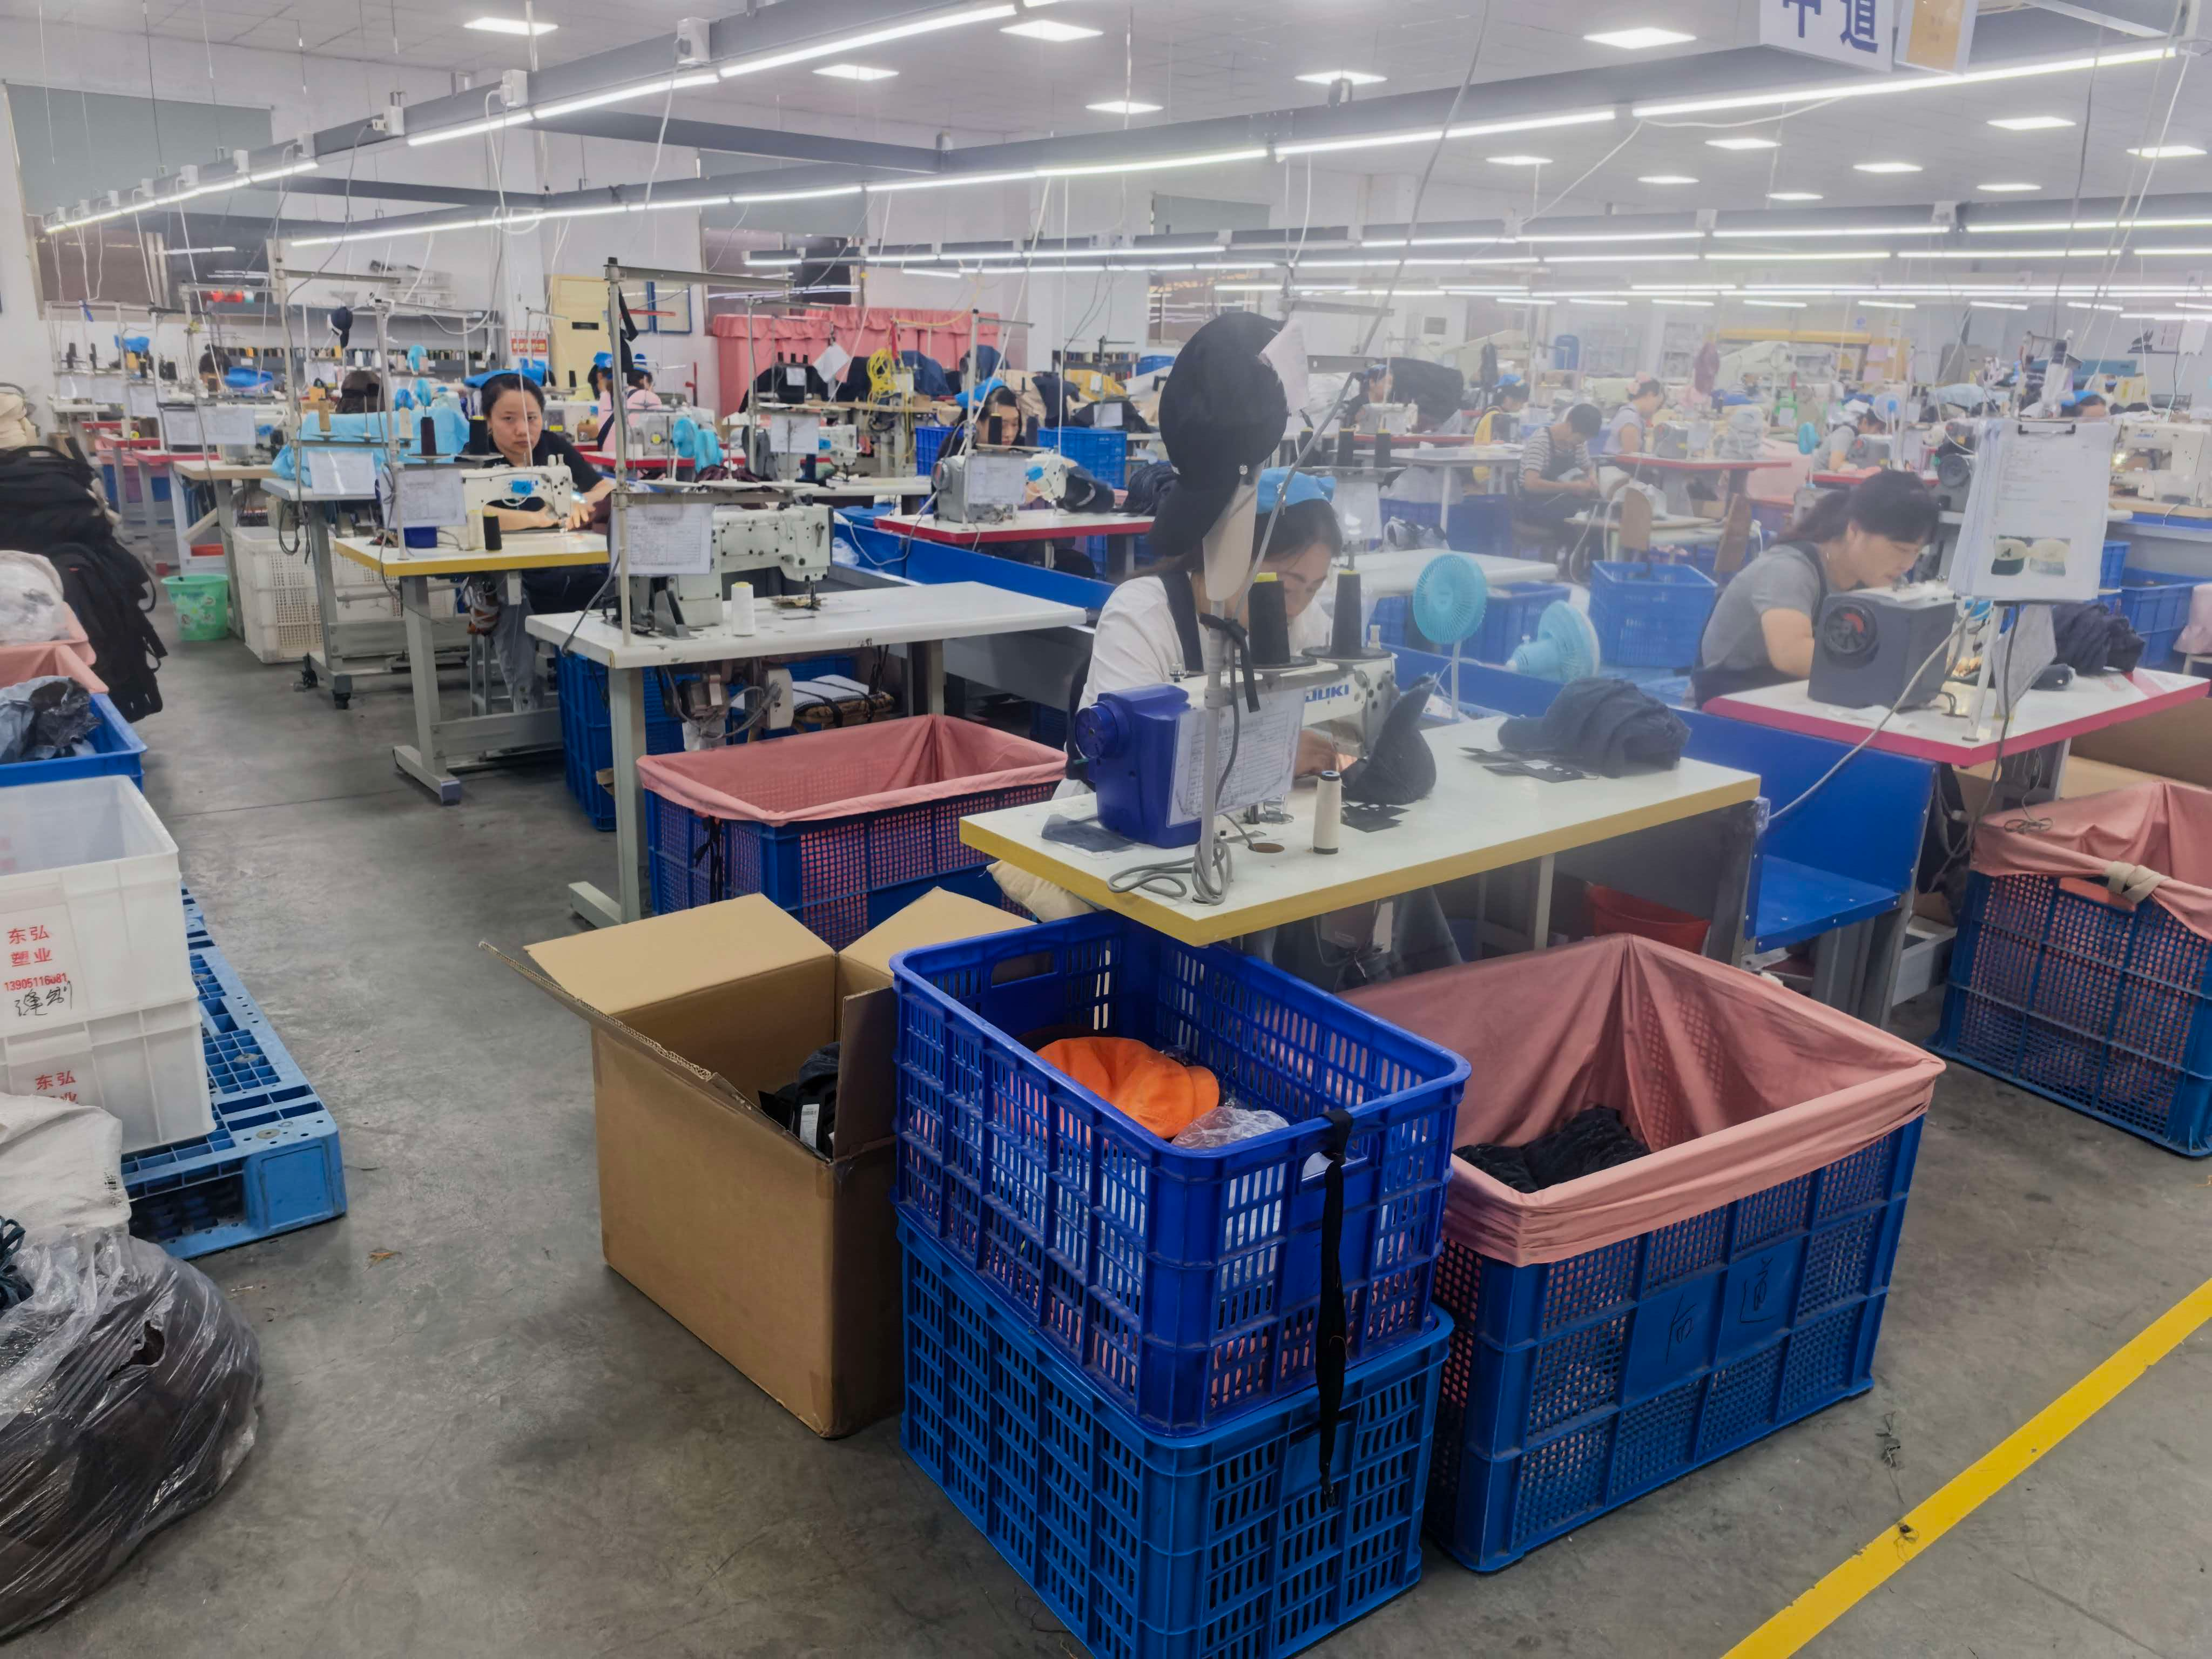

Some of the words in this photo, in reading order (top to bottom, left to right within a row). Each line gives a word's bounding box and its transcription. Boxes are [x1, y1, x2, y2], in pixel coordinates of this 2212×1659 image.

[1305, 684, 1349, 702] JUKI
[7, 925, 50, 944] 东弘
[11, 948, 52, 967] 塑业
[35, 1070, 76, 1090] 东弘
